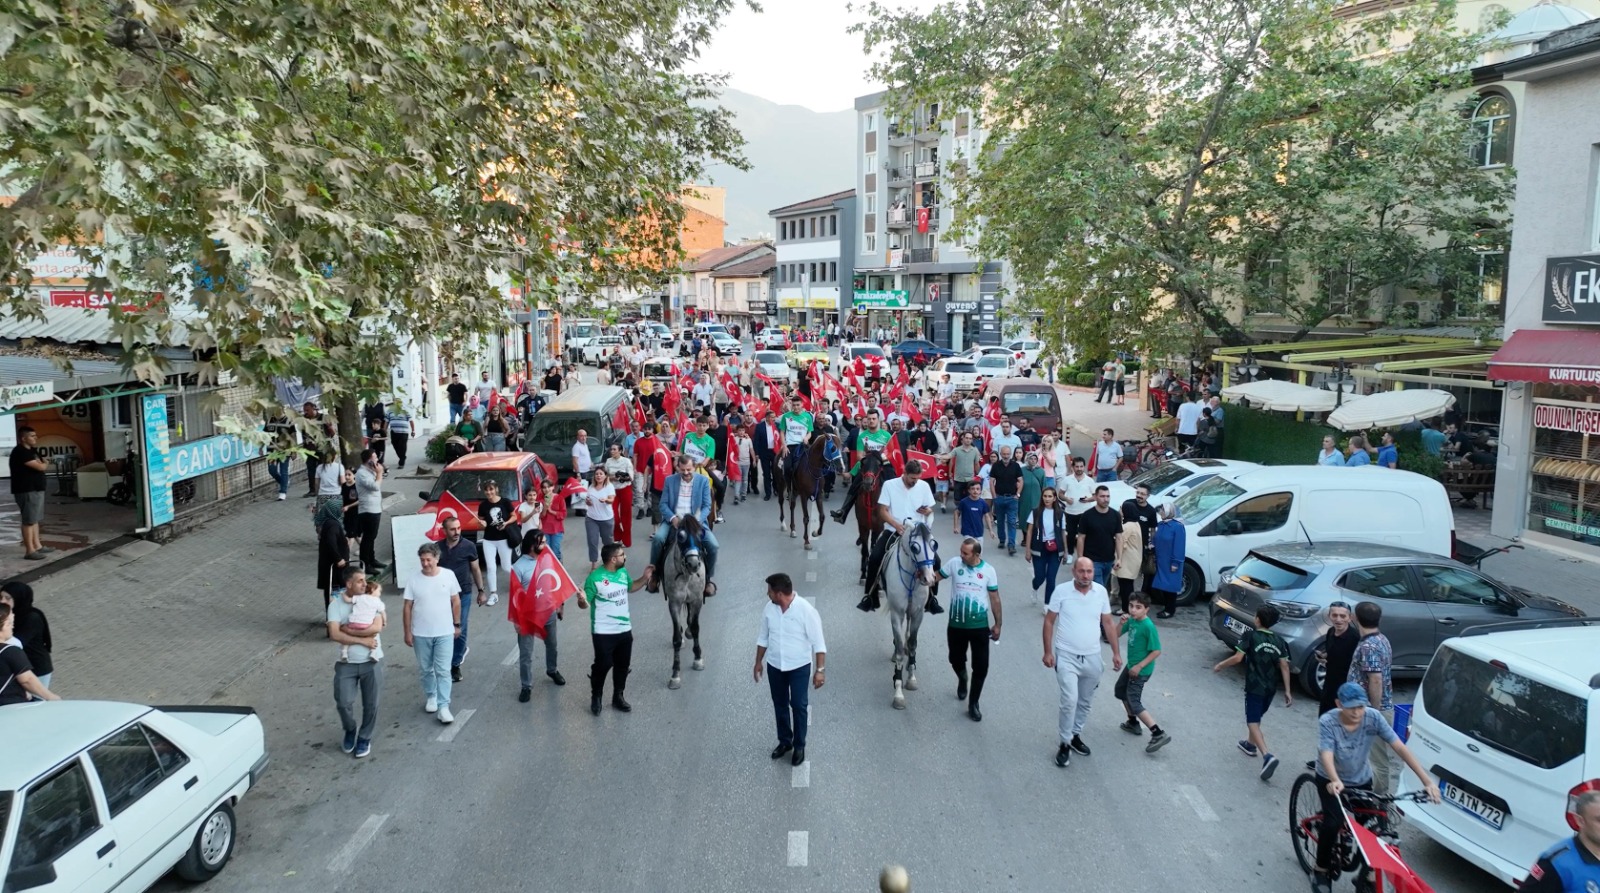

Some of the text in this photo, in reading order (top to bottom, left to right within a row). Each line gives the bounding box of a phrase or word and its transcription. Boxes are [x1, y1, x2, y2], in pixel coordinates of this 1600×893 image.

[8, 384, 46, 397] IKAMA
[1536, 406, 1572, 430] ODUNLA
[176, 443, 214, 476] CAN
[220, 436, 253, 464] OTO
[1446, 783, 1501, 824] 16 ATN 772
